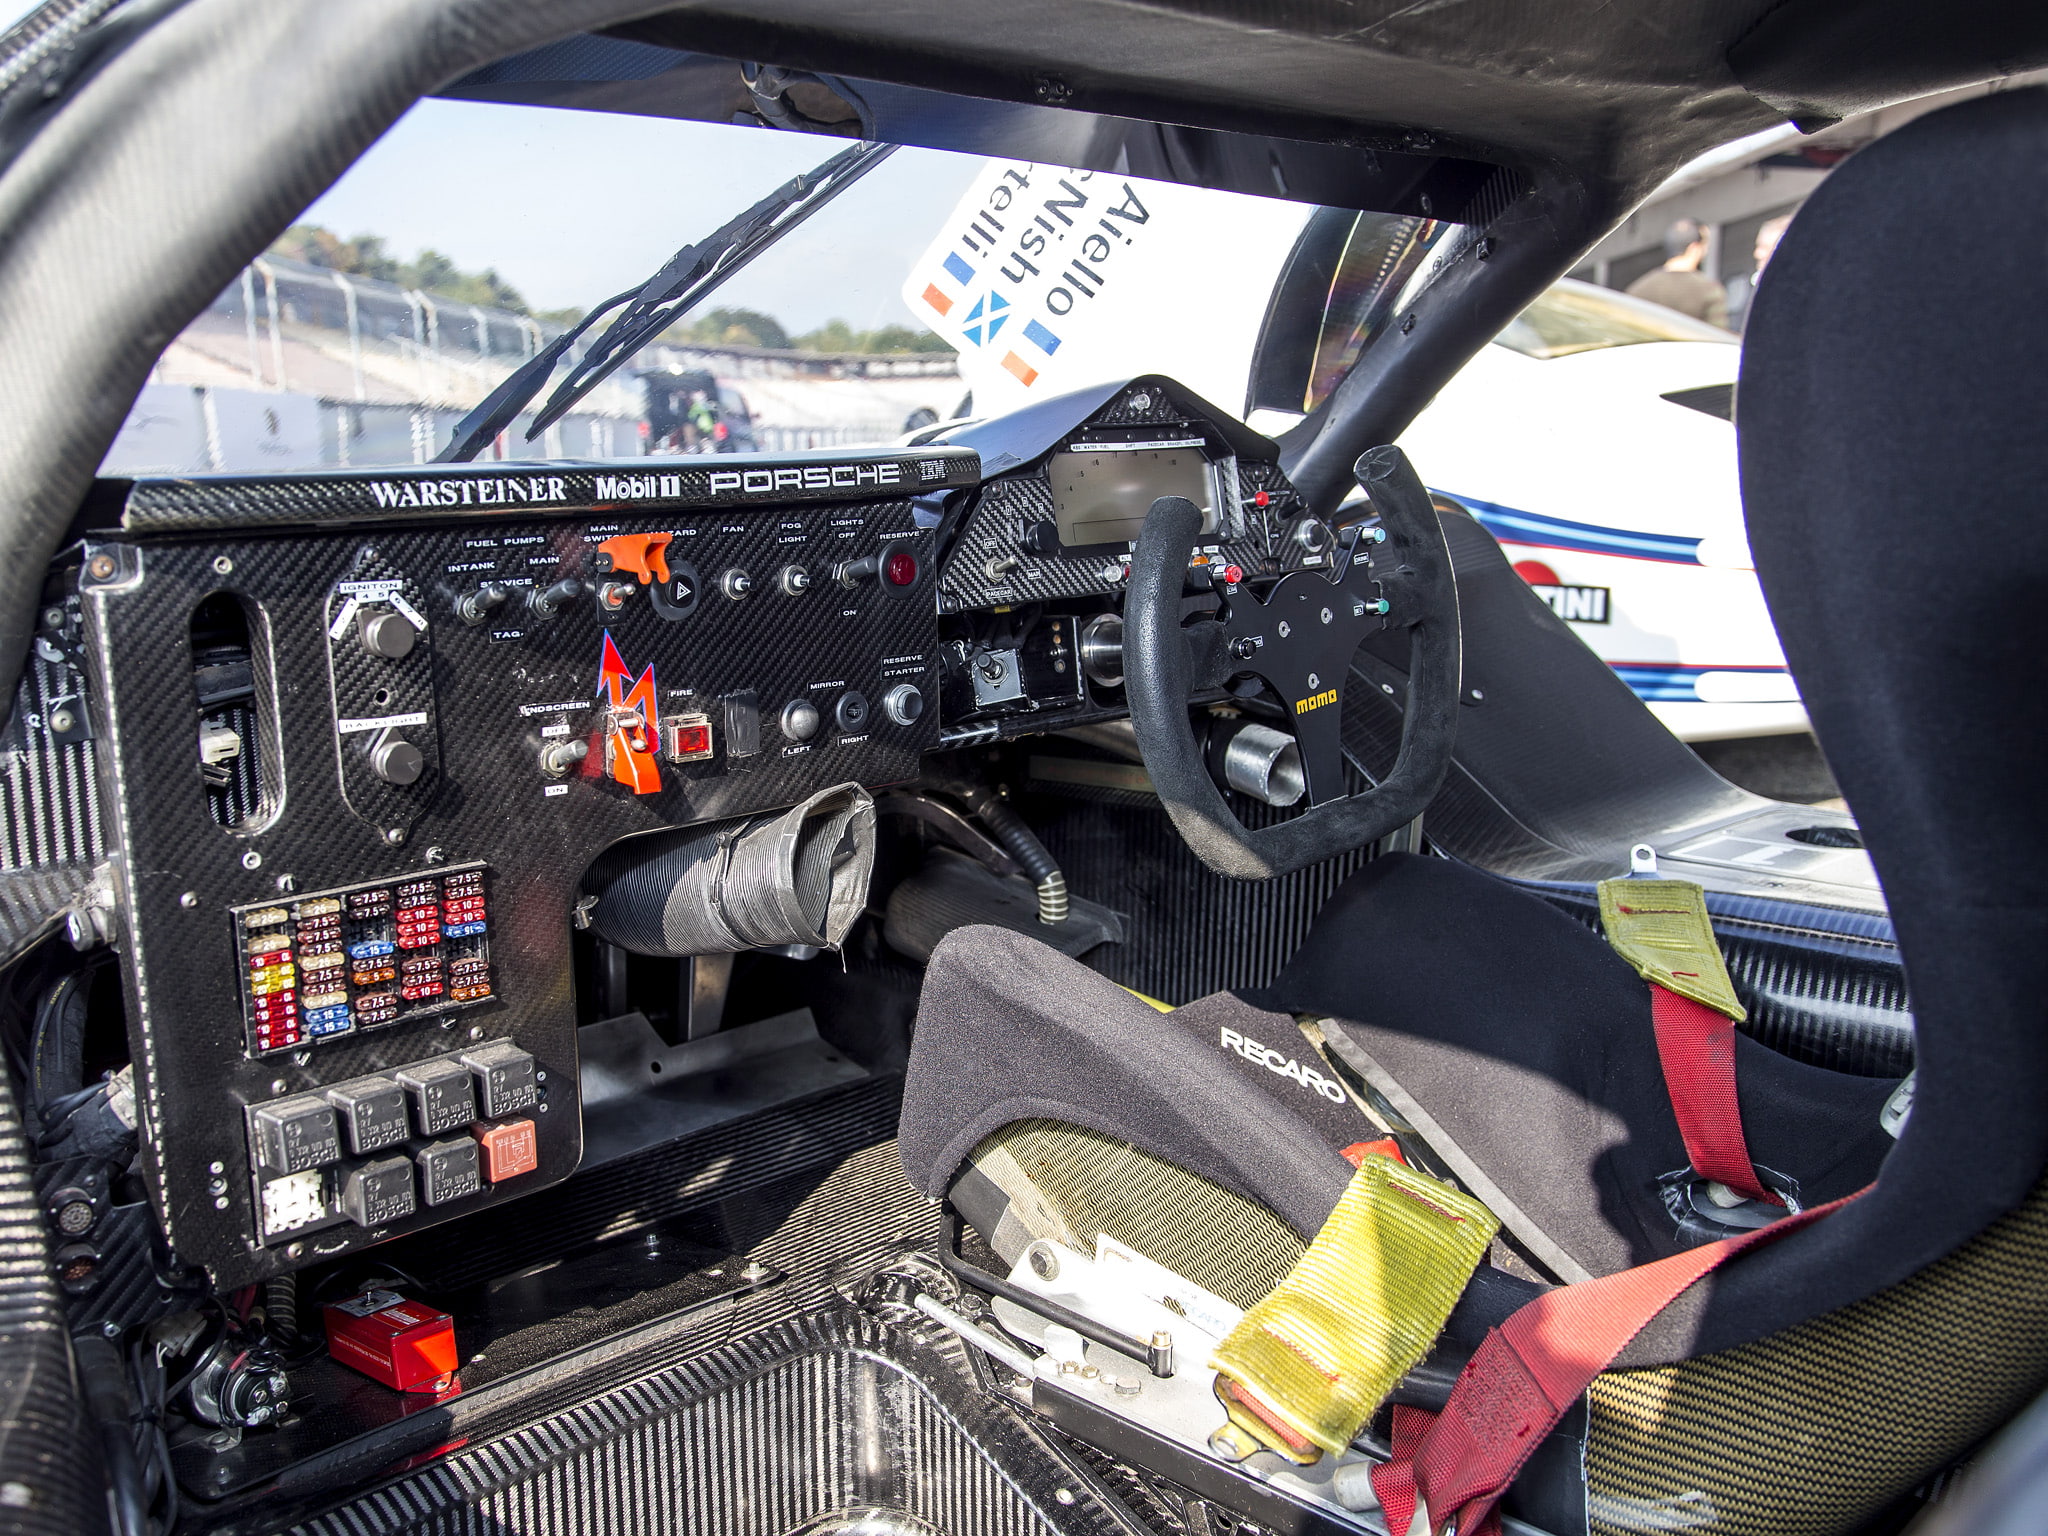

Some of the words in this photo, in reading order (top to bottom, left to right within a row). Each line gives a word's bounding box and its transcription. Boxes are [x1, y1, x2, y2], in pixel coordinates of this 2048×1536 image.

[962, 163, 1033, 259] telli
[1046, 182, 1150, 316] Aiello
[710, 463, 900, 495] PORSCHE
[370, 476, 567, 508] WARSTEINER
[596, 476, 656, 499] Mobil
[781, 522, 802, 530] FOG
[830, 519, 864, 527] LIGHTS
[650, 529, 697, 537] ZARD
[722, 525, 744, 534] FAN
[879, 530, 920, 540] RESERVE
[466, 538, 498, 548] FUEL
[504, 536, 545, 546] PUMPS
[778, 535, 807, 544] LIGHT
[529, 556, 560, 566] MAIN
[447, 561, 495, 573] INTANK
[343, 582, 398, 591] IGNITON
[883, 654, 923, 665] RESERVE
[884, 666, 925, 677] STARTER
[810, 680, 845, 690] MIRROR
[670, 689, 693, 698] FIRE
[520, 701, 590, 715] NDSCREEN
[841, 735, 870, 745] RIGHT
[787, 745, 812, 755] LEFT
[458, 873, 472, 884] 7.5
[411, 883, 425, 894] 7.5
[458, 886, 473, 897] 7.5
[363, 892, 378, 903] 7.5
[412, 895, 426, 906] 7.5
[462, 900, 473, 910] 10
[365, 906, 379, 918] 7.5
[415, 910, 425, 920] 10
[463, 913, 474, 922] 10
[313, 917, 329, 928] 7.5
[416, 923, 427, 933] 10
[314, 930, 329, 941] 7.5
[417, 936, 428, 945] 10
[316, 943, 331, 954] 7.5
[369, 946, 380, 955] 15
[254, 957, 265, 968] 10
[368, 958, 382, 969] 7.5
[416, 960, 431, 970] 7.5
[464, 962, 478, 973] 7.5
[319, 970, 332, 980] 7.5
[374, 972, 380, 981] 5
[417, 973, 432, 984] 7.5
[465, 975, 480, 986] 7.5
[319, 983, 333, 993] 7.5
[420, 986, 431, 996] 10
[470, 988, 476, 997] 5
[256, 997, 267, 1008] 10
[372, 997, 385, 1008] 7.5
[259, 1011, 269, 1020] 10
[324, 1009, 334, 1019] 15
[372, 1010, 386, 1020] 7.5
[260, 1024, 270, 1034] 10
[324, 1022, 335, 1032] 15
[260, 1039, 270, 1050] 10
[1220, 1026, 1347, 1104] RECARO
[494, 1092, 536, 1116] BOSCH
[431, 1108, 475, 1132] BOSCH
[361, 1127, 408, 1151] BOSCH
[290, 1146, 339, 1172] BOSCH
[435, 1178, 479, 1203] BOSCH
[368, 1199, 414, 1225] BOSCH
